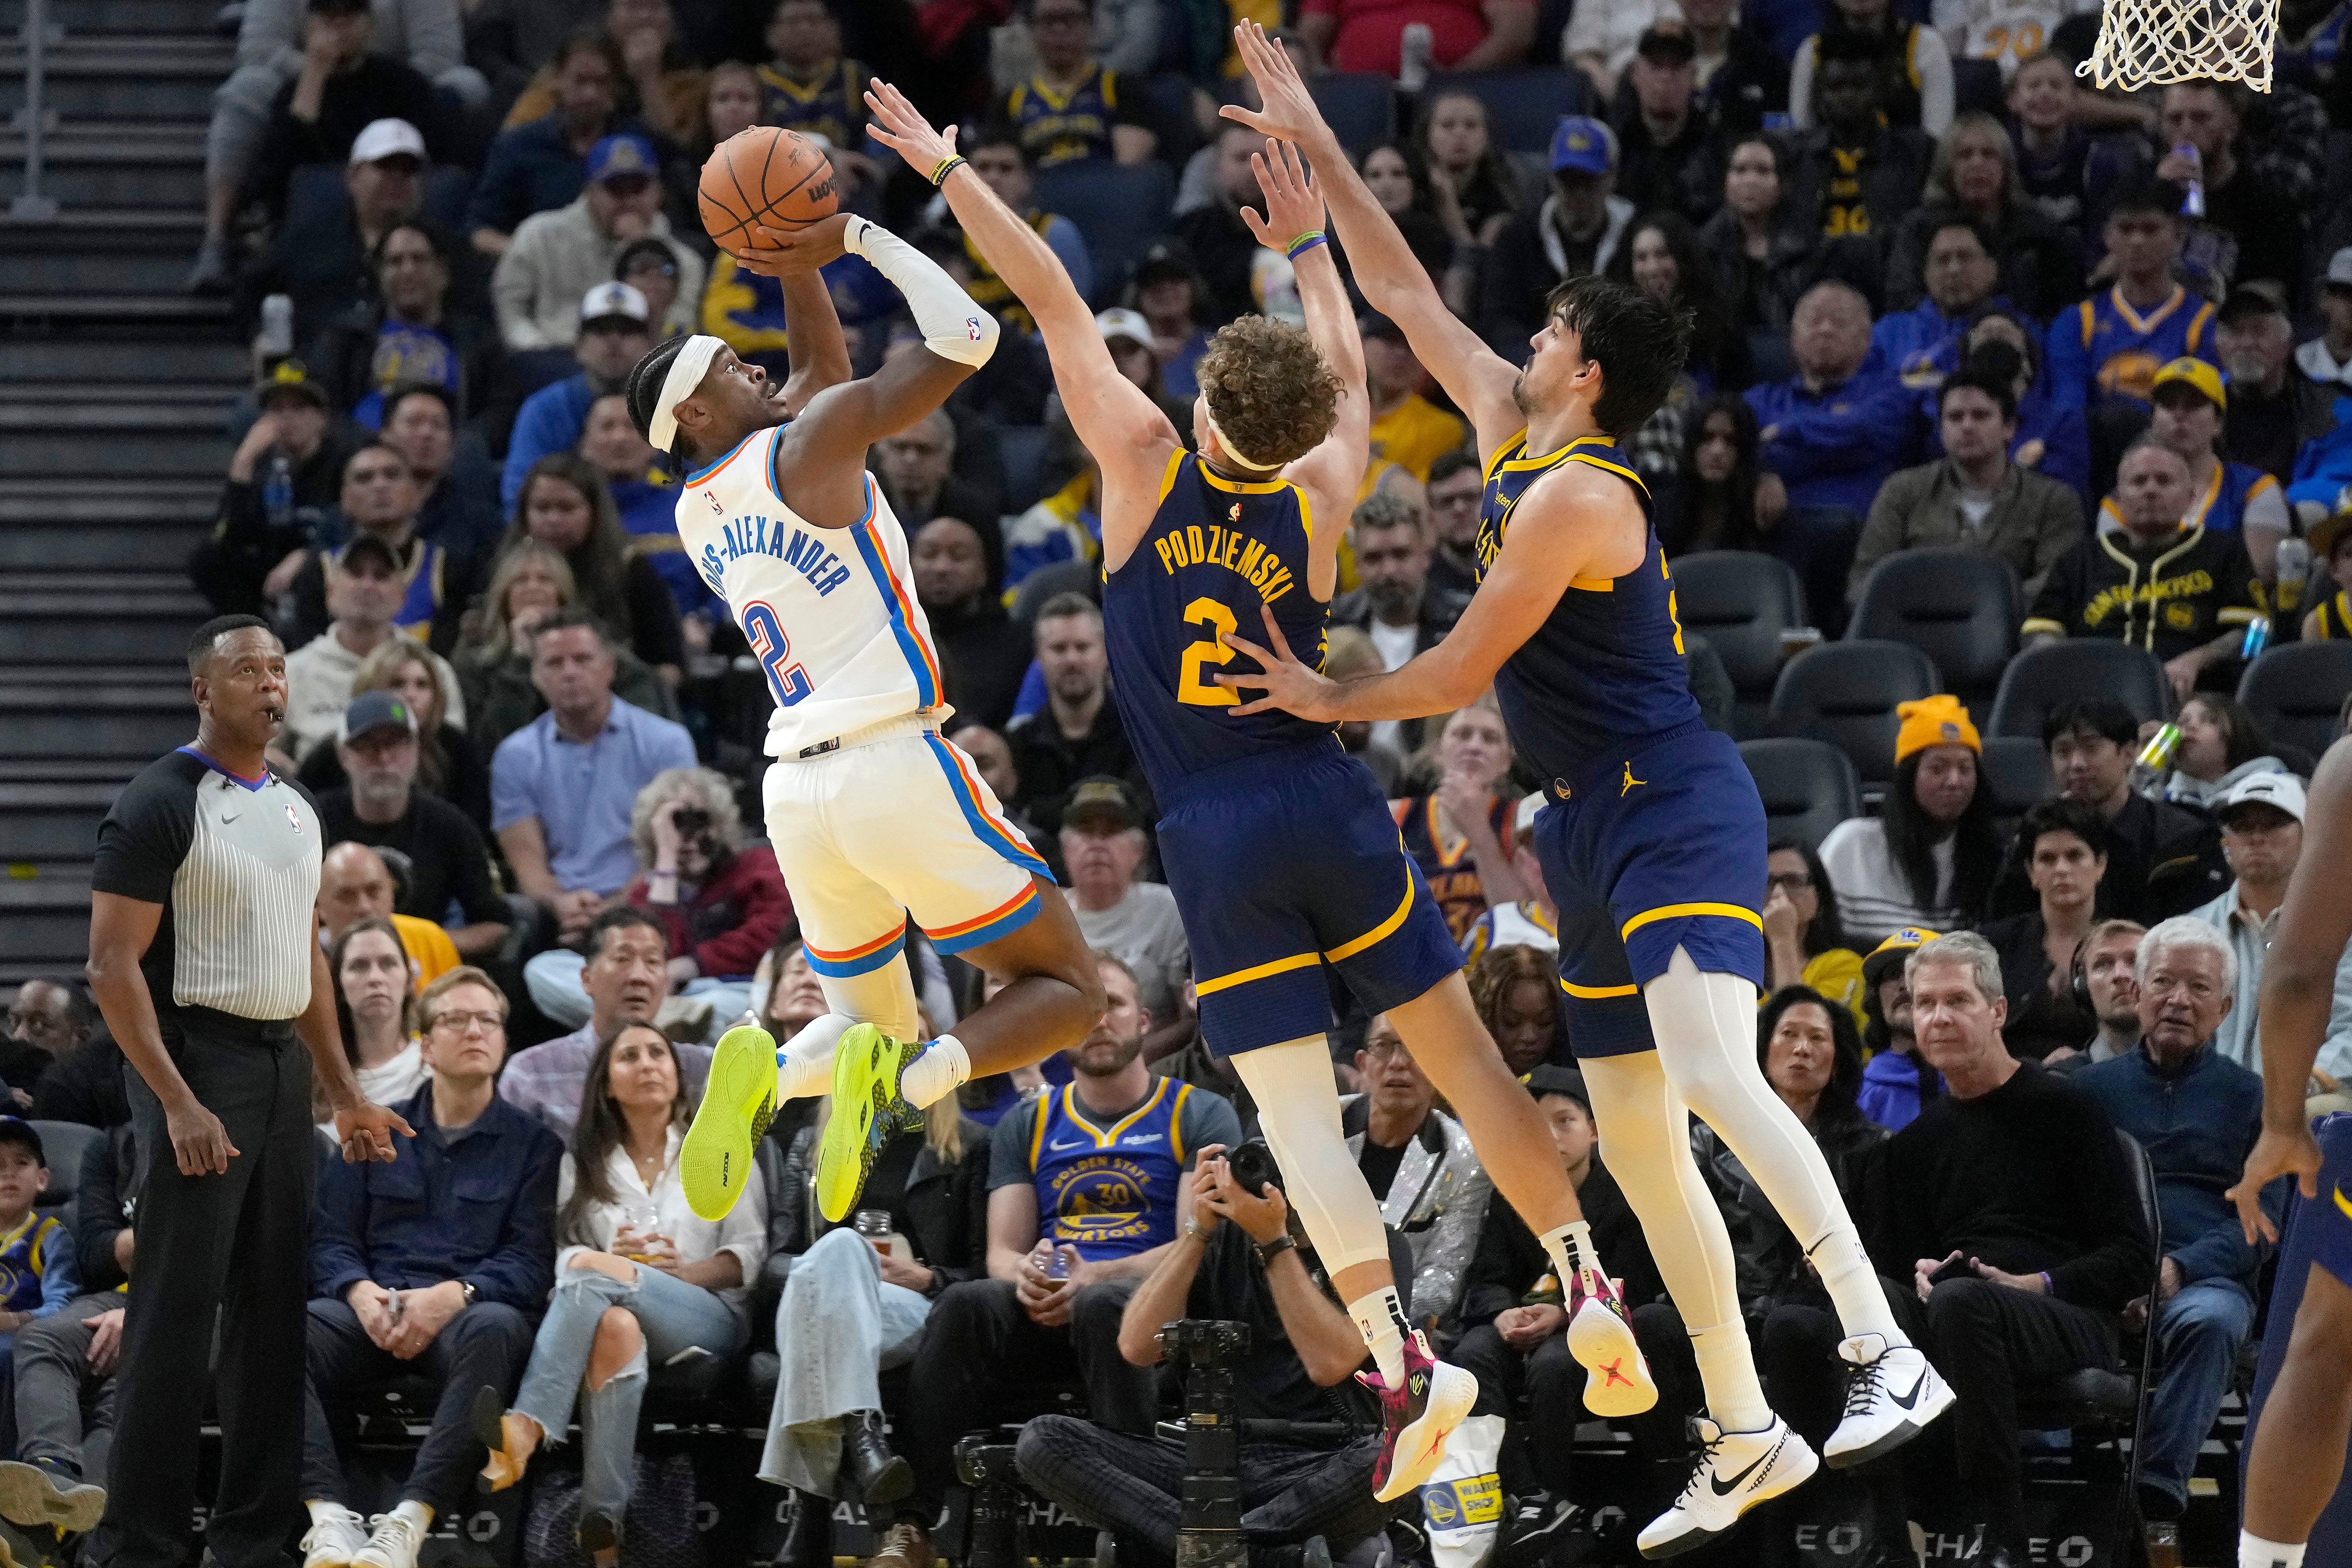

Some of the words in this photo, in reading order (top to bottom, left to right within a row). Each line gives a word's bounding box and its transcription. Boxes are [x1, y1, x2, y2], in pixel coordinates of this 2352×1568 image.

[936, 159, 947, 171] FAMILY
[940, 165, 953, 178] NAME
[1495, 491, 1511, 509] uten
[702, 516, 850, 602] OUS-ALEXANDER
[1154, 525, 1294, 604] PODZIEMSKI
[742, 600, 815, 707] 2
[1177, 597, 1241, 706] 2
[1051, 1156, 1108, 1189] GOLDEN
[1113, 1157, 1152, 1186] STATE
[1095, 1183, 1131, 1206] 30
